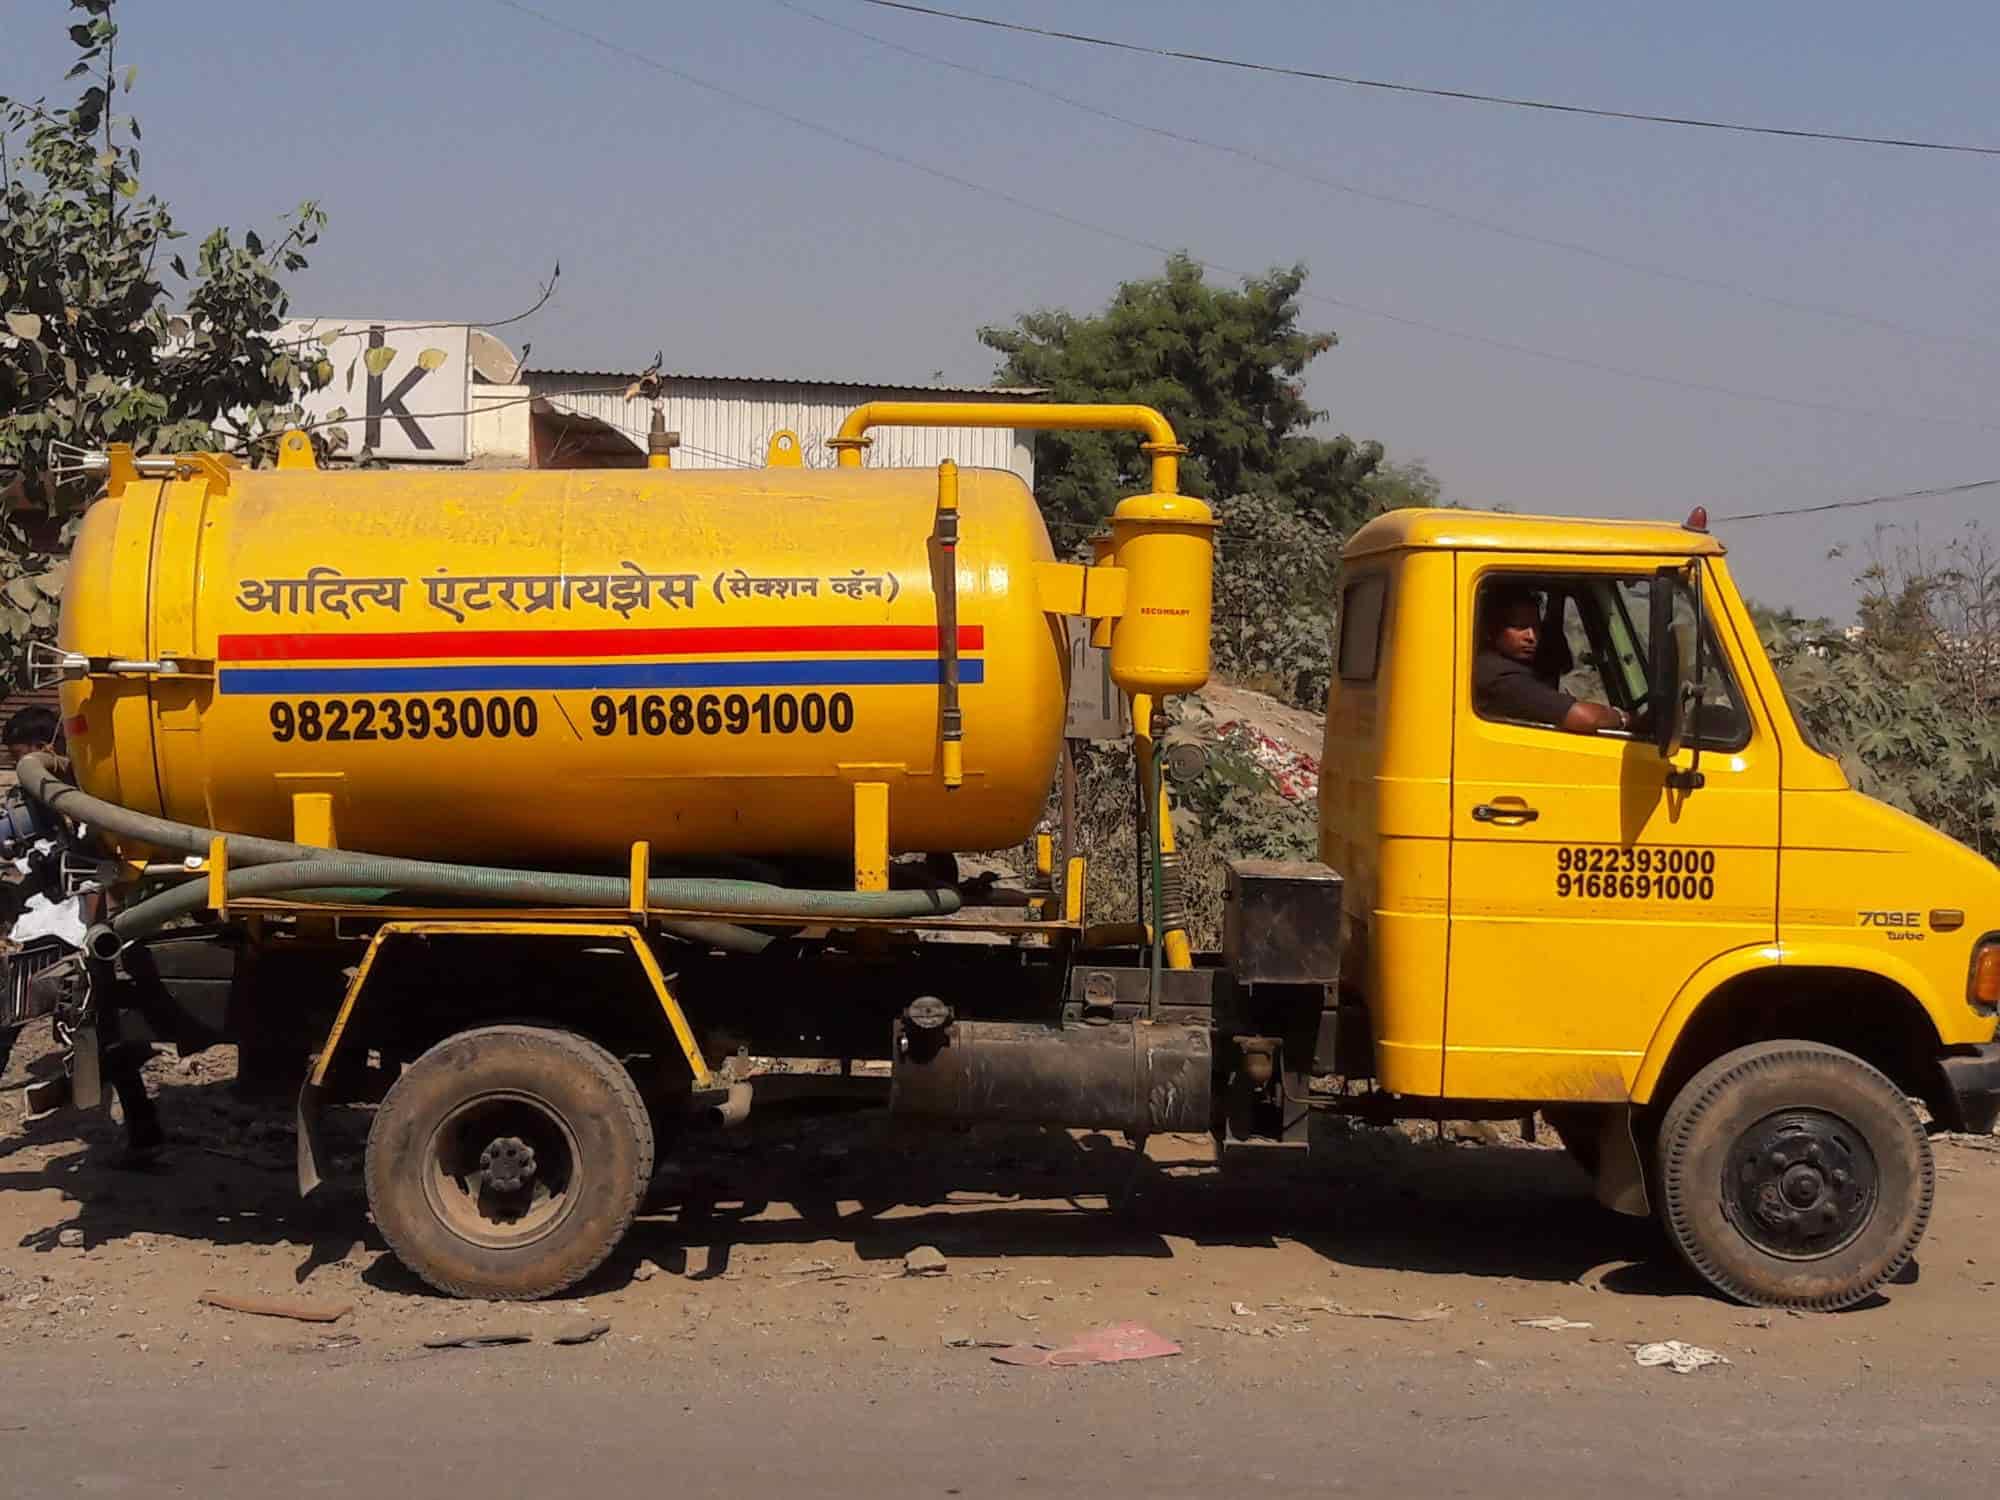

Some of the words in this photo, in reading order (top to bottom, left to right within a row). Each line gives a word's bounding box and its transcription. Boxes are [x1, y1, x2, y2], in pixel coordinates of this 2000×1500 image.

[236, 567, 409, 620] आदित्य
[421, 561, 699, 623] एंटरप्रायझेस
[269, 697, 538, 742] 9822393000
[591, 692, 854, 736] 9168691000
[1557, 848, 1715, 874] 9822393000
[1556, 873, 1714, 900] 9168691000
[1857, 911, 1921, 928] 709E
